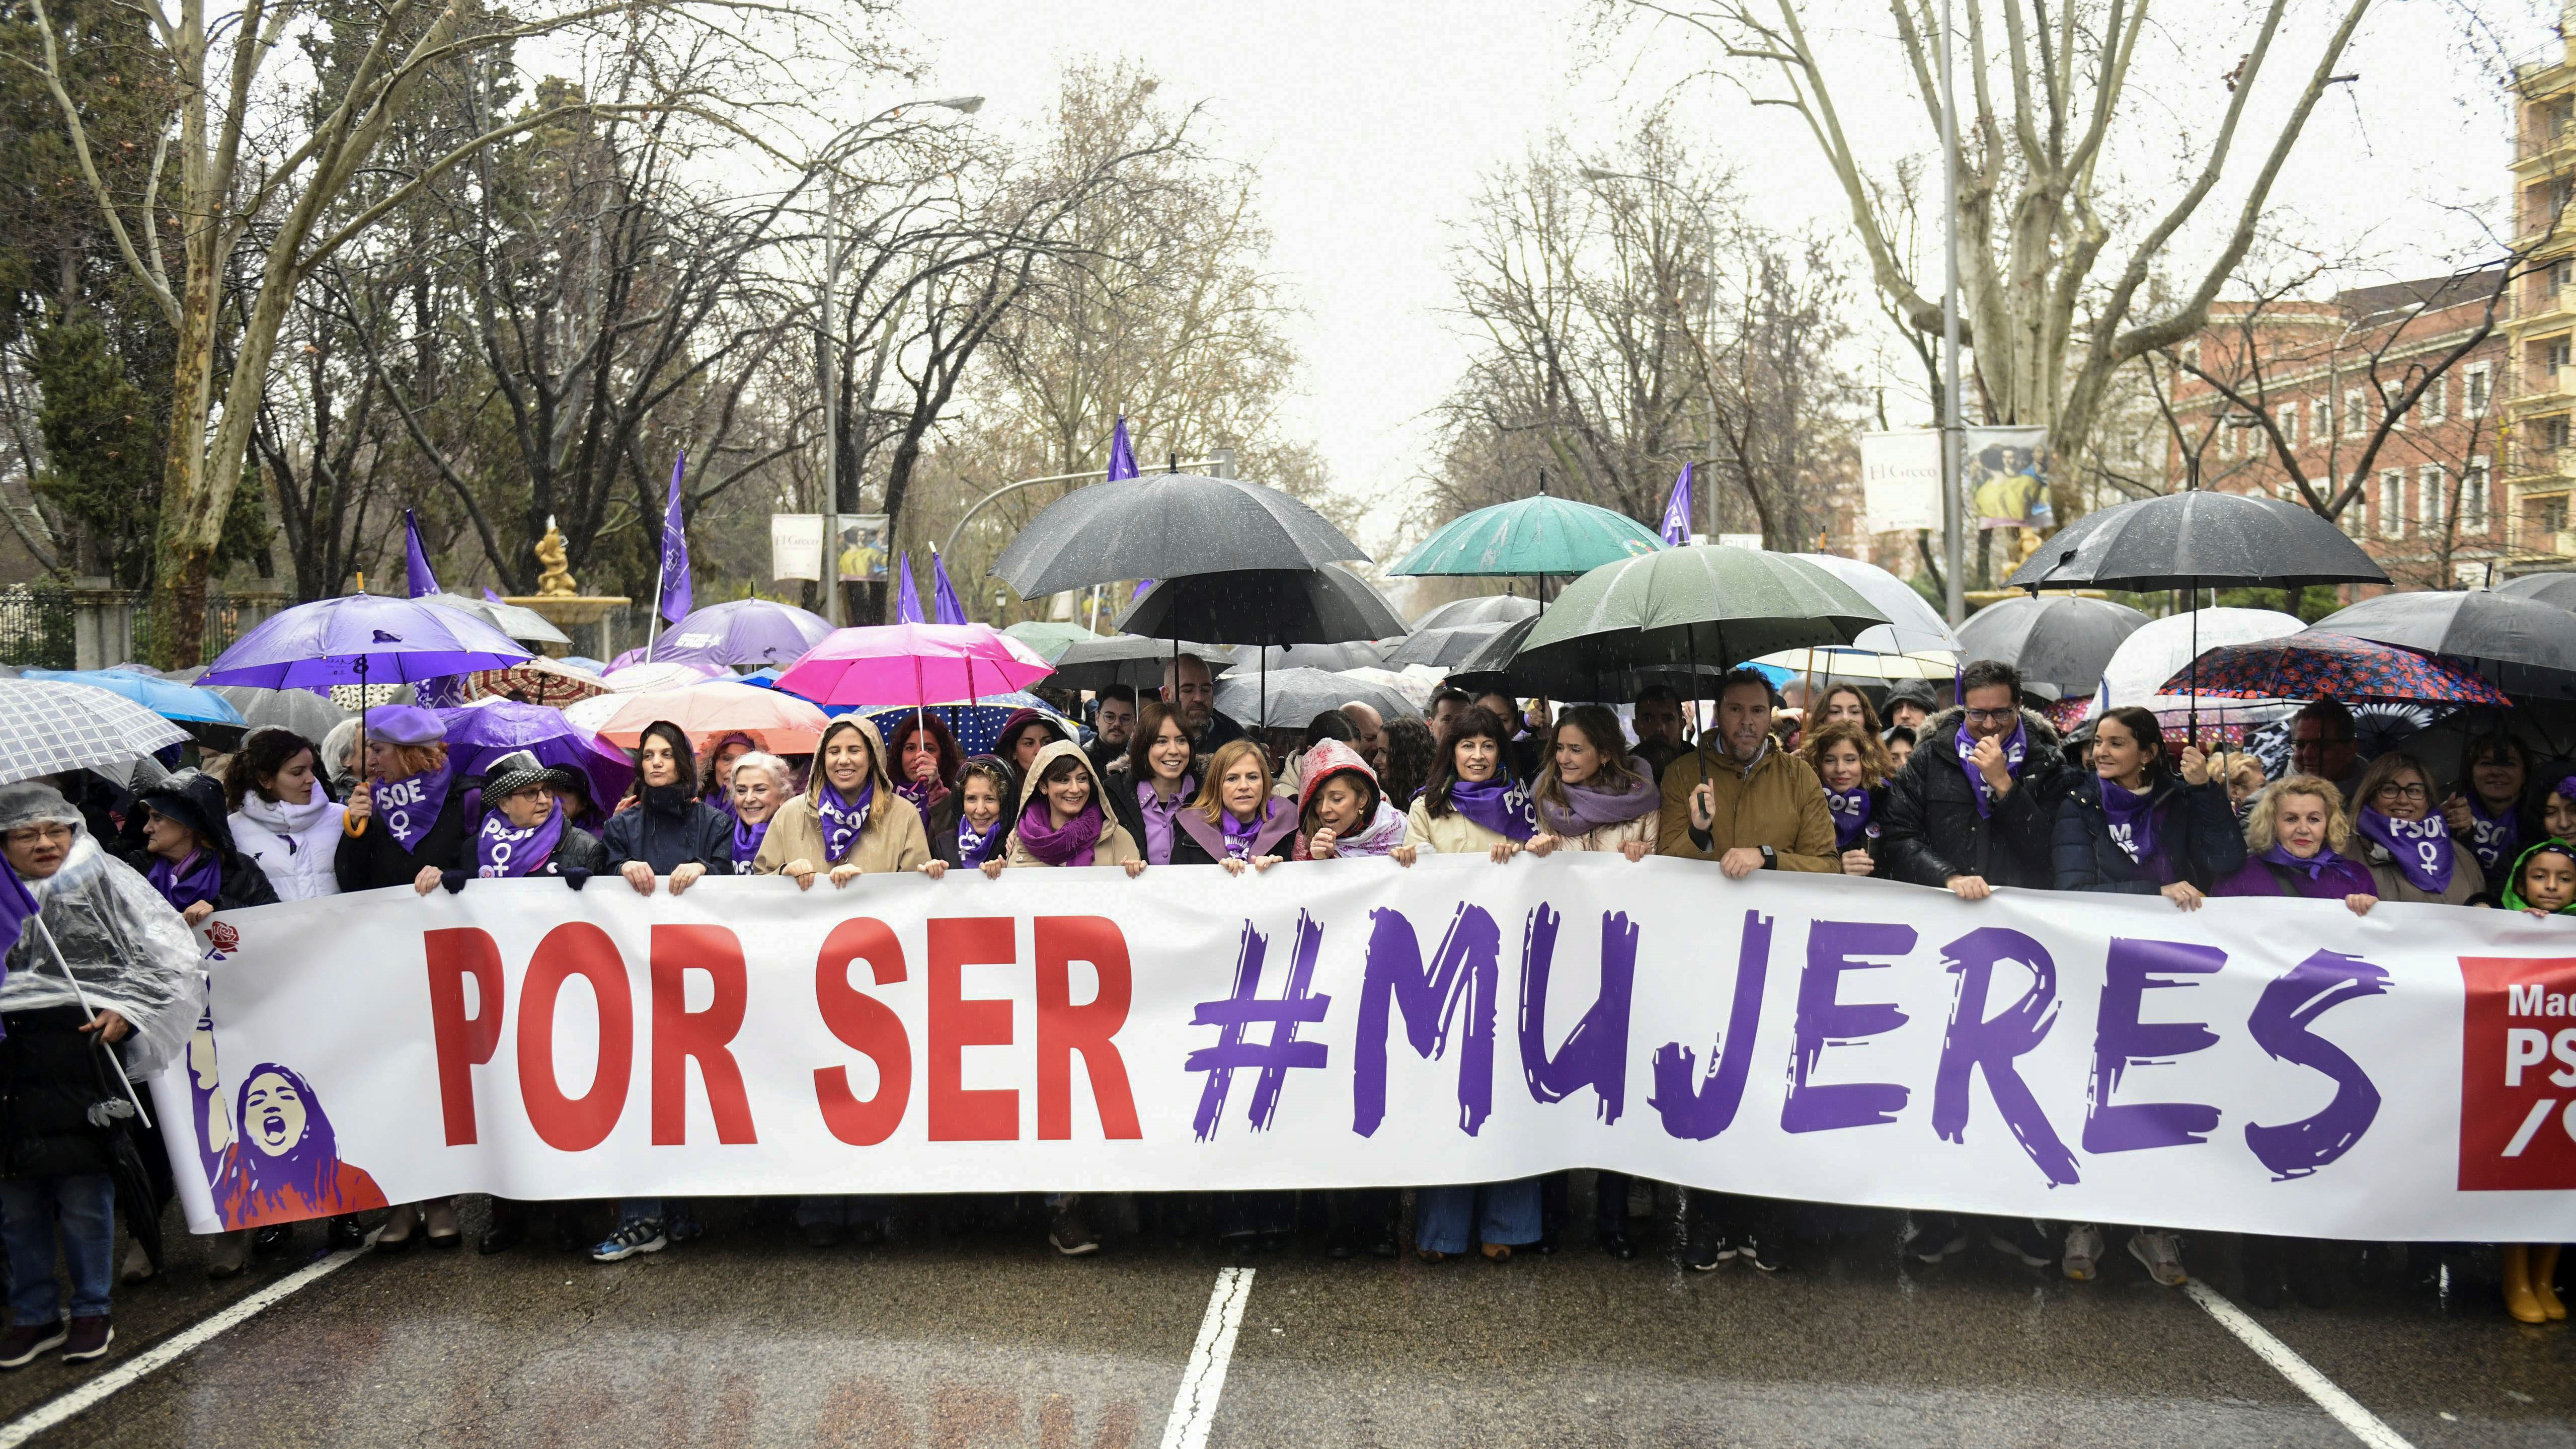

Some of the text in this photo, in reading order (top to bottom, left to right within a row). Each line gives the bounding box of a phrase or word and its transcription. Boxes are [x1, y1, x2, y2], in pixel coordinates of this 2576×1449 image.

[1869, 463, 1936, 480] El Greco
[788, 535, 819, 545] Greco
[2390, 815, 2447, 839] PSOE
[424, 902, 2393, 1188] POR SER #MUJERES
